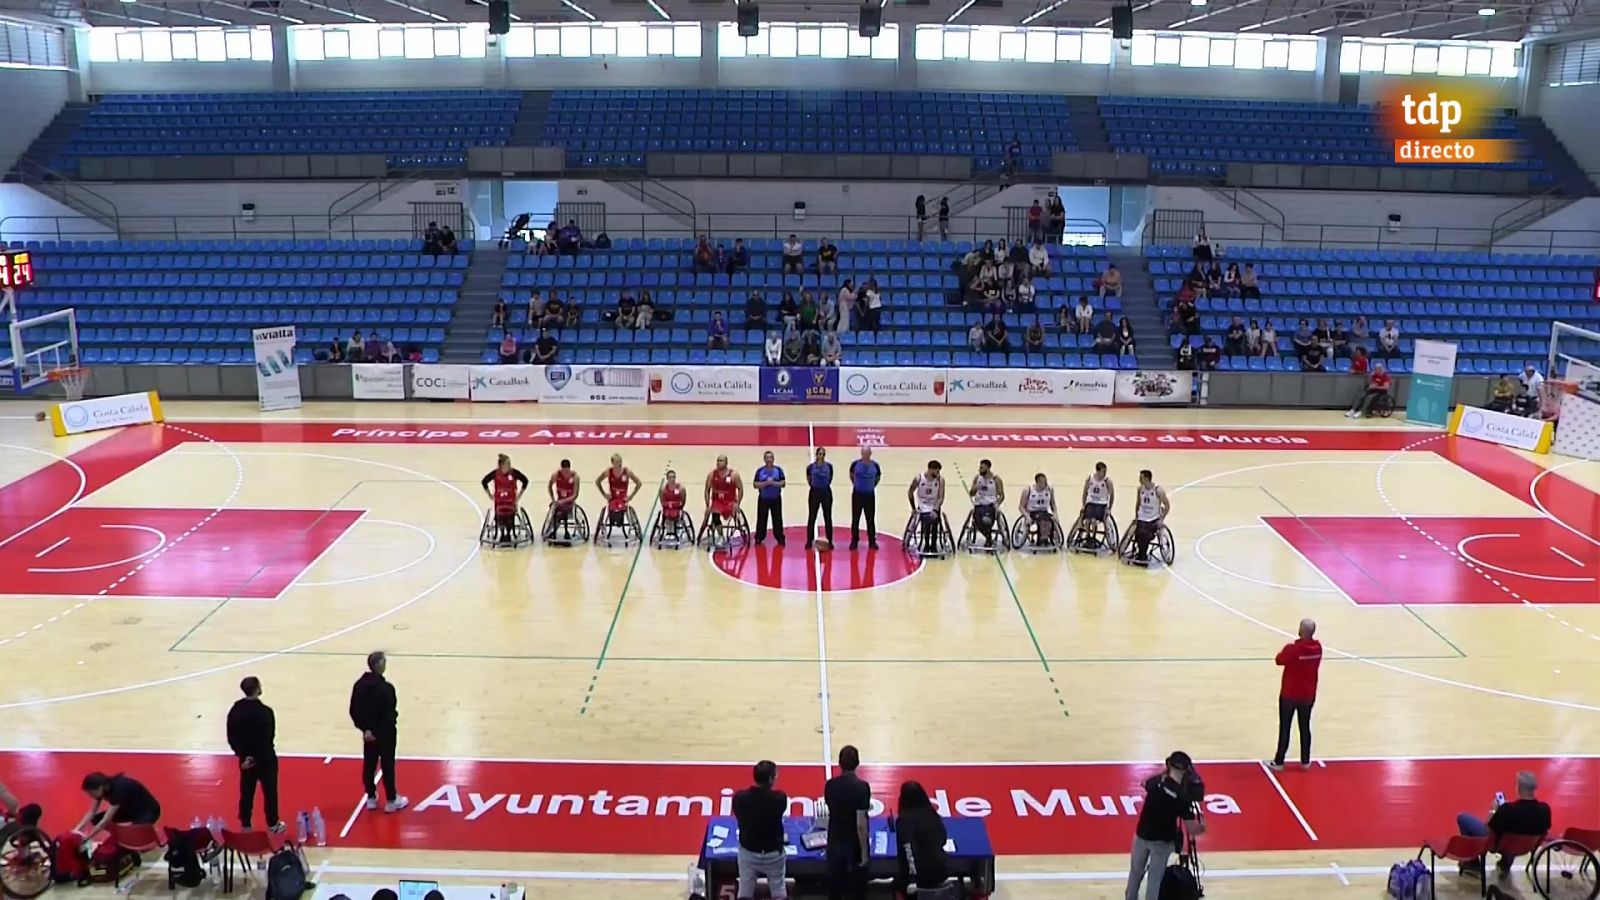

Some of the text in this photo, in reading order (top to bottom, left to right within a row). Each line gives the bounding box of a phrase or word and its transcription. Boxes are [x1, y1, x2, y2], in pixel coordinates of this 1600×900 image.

[13, 263, 32, 285] 24
[489, 376, 530, 386] CaixaBank
[697, 381, 721, 390] Costa
[872, 381, 897, 391] Costa
[967, 380, 1008, 389] CaixaBank
[805, 386, 833, 395] UCAM
[93, 408, 119, 418] Costa
[332, 428, 669, 439] Príncipe de Asturias
[1486, 423, 1510, 434] Costa
[930, 432, 1309, 444] Ayuntamiento de Murcia
[1009, 788, 1242, 817] Mura
